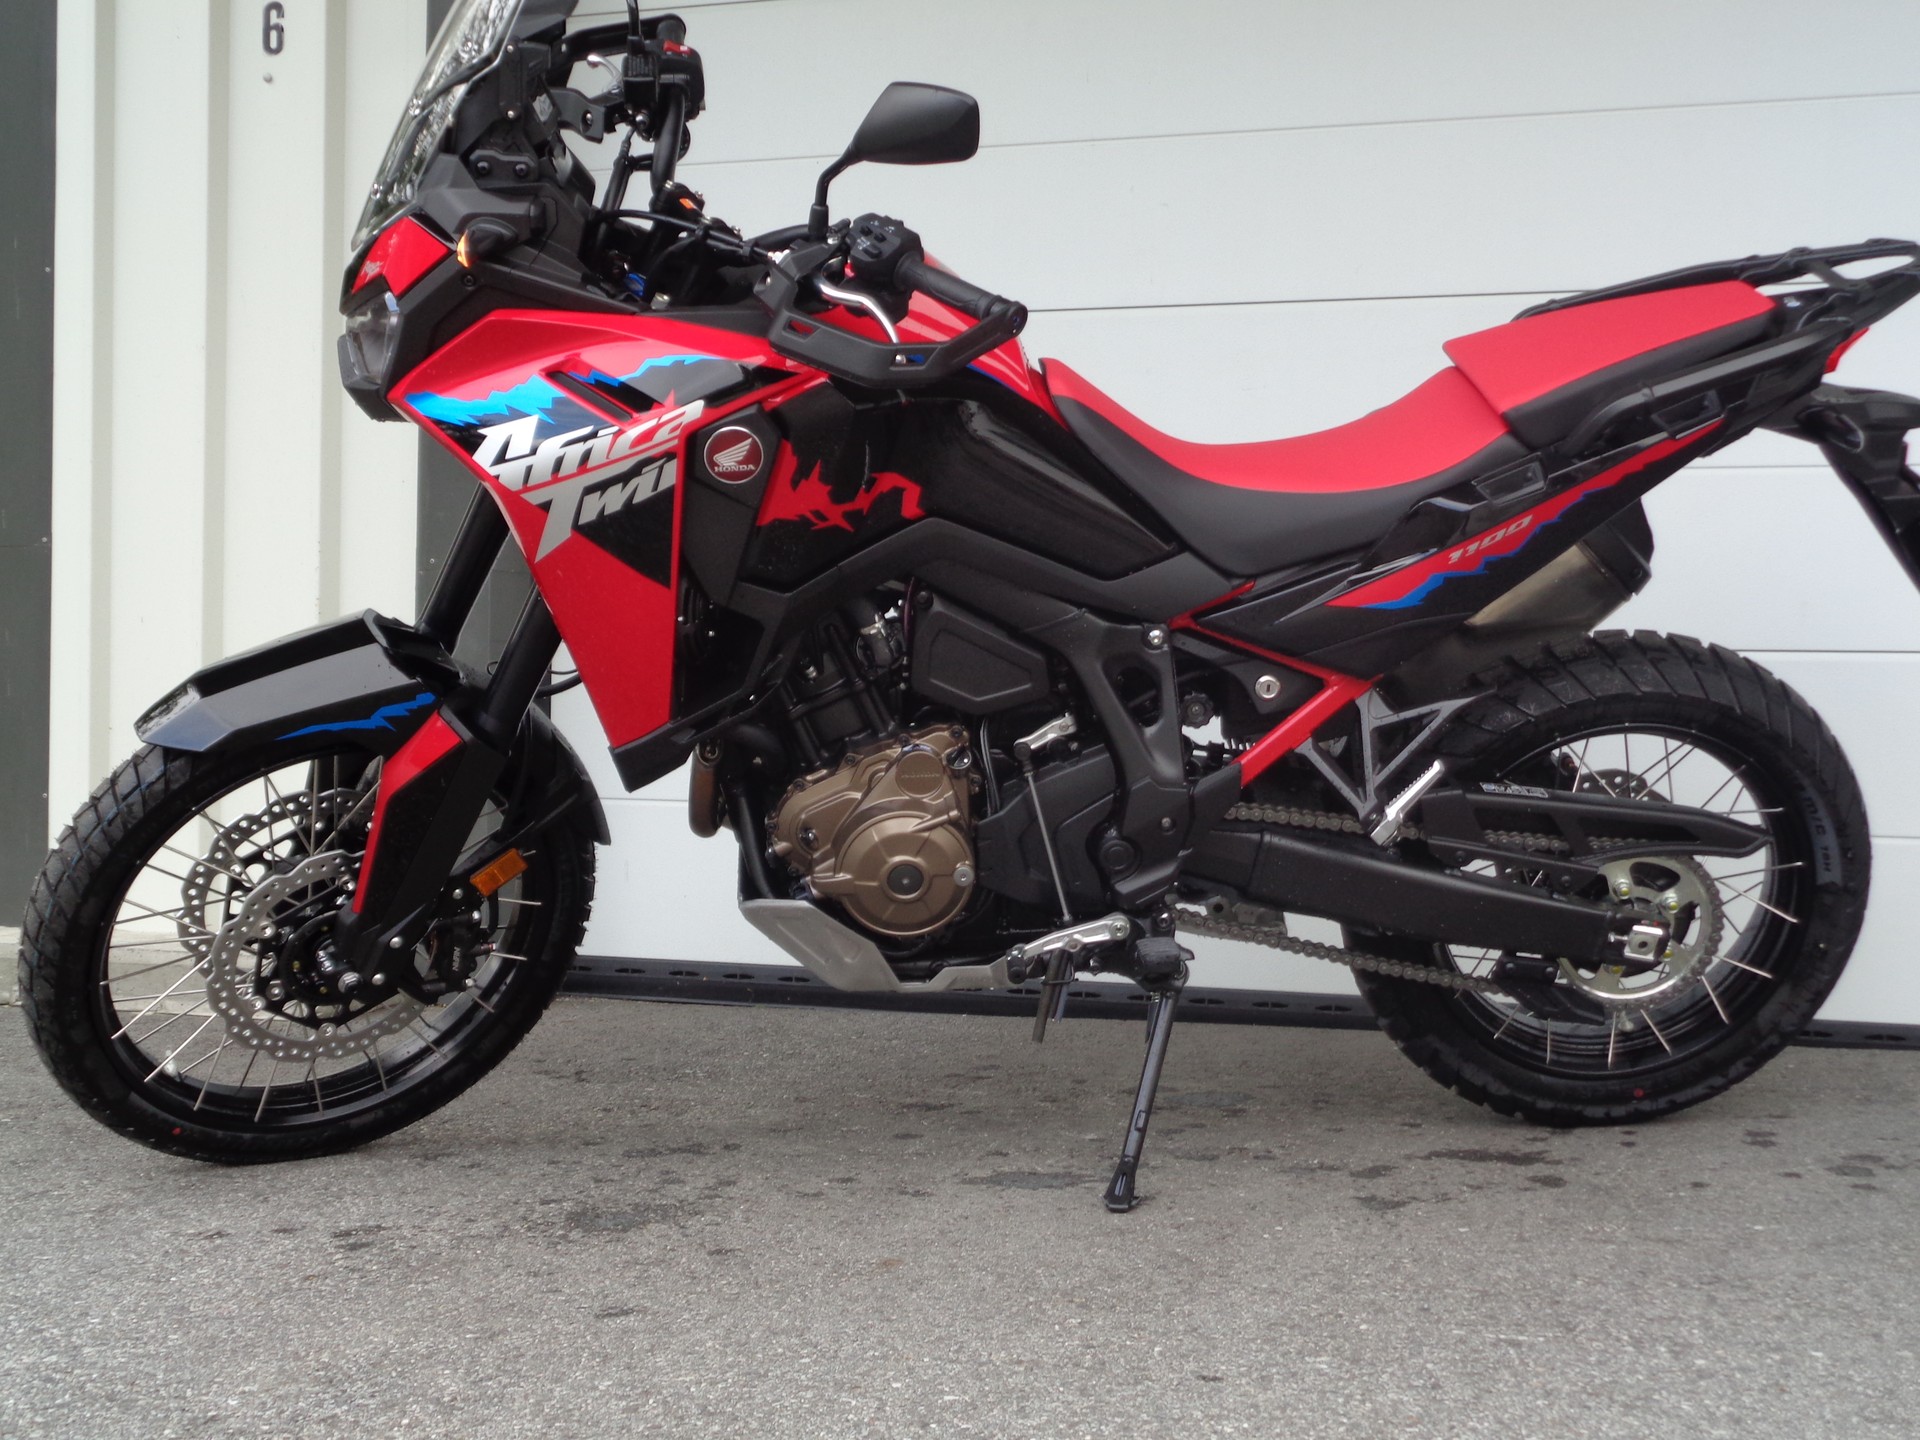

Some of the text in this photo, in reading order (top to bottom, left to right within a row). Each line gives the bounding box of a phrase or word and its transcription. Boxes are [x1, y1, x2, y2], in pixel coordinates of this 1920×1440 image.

[262, 1, 285, 55] 6
[471, 399, 704, 491] Africa
[714, 464, 756, 473] HONDA
[1448, 514, 1533, 565] 1100
